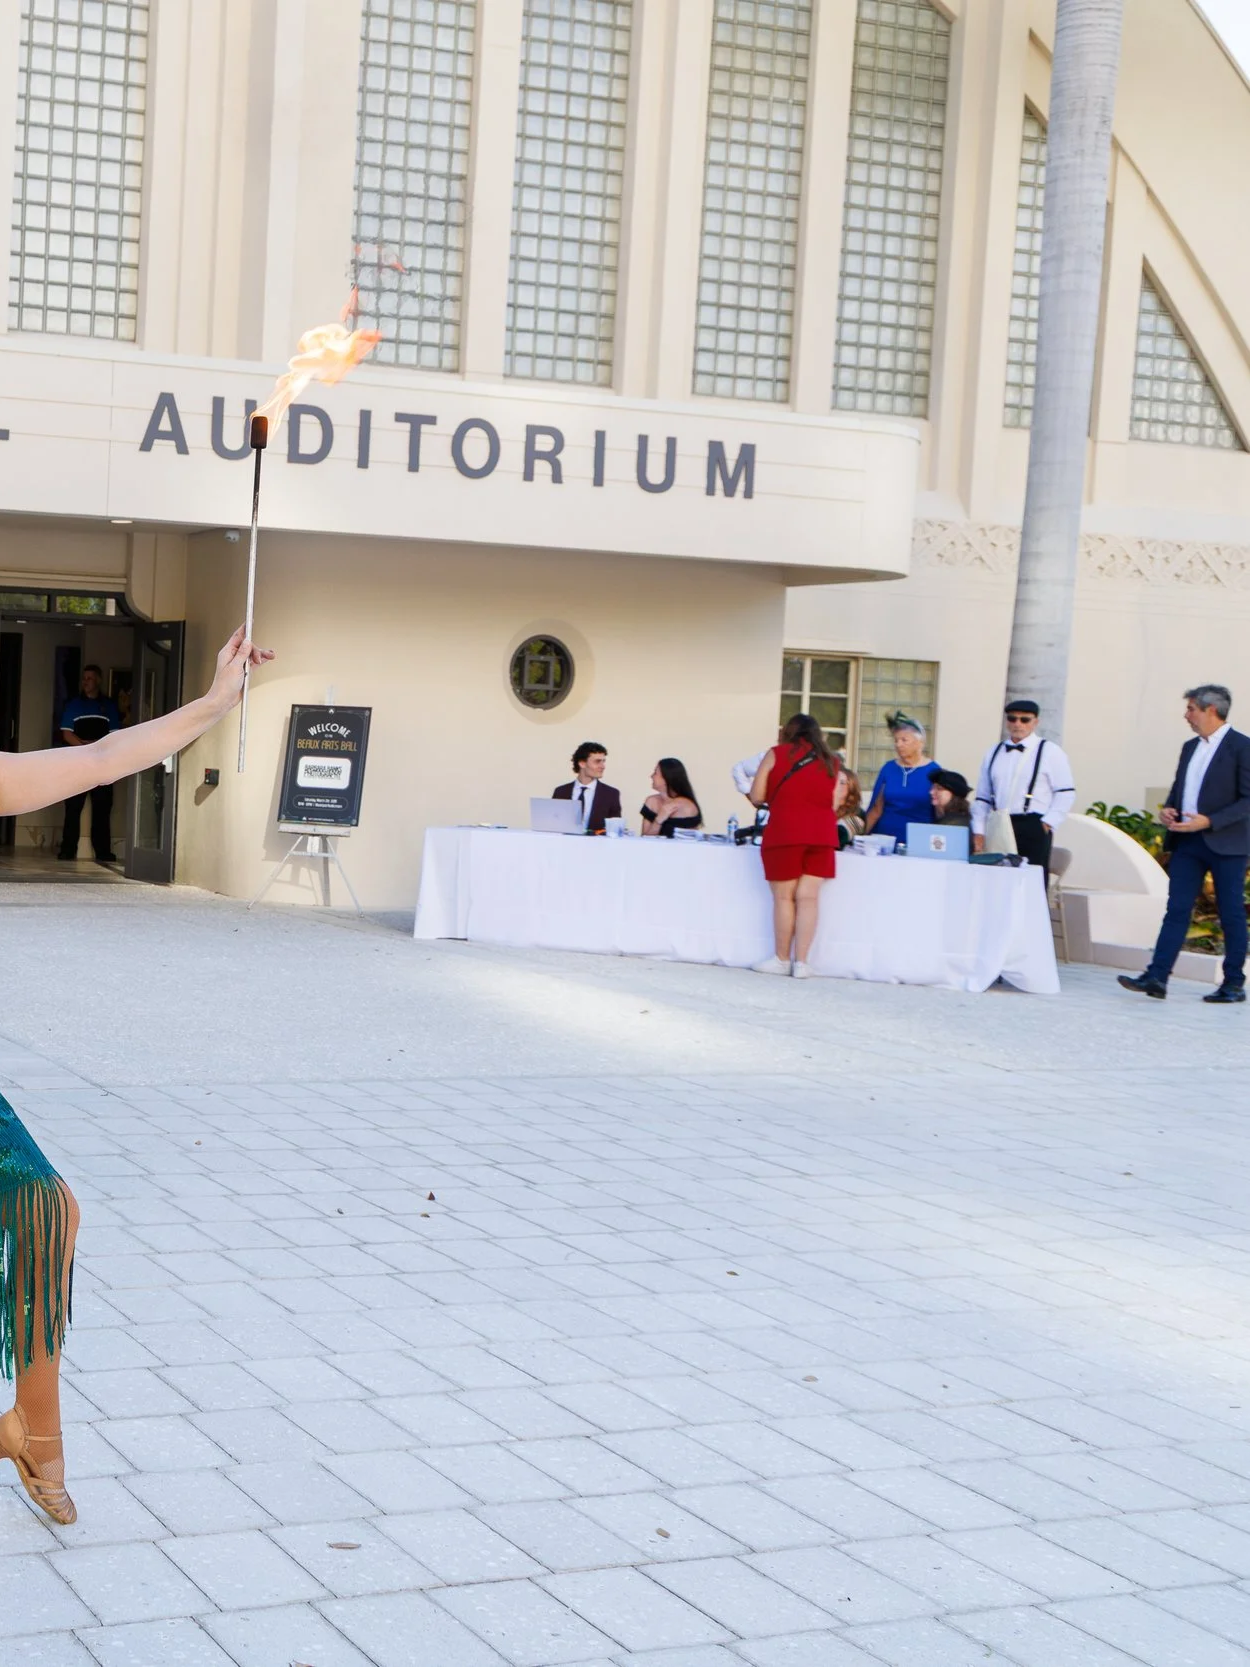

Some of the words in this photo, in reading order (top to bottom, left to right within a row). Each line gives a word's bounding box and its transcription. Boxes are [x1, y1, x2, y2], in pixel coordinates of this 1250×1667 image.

[139, 391, 756, 500] AUDITORIUM
[308, 723, 351, 738] WELCOME
[297, 739, 320, 749] BEAUX
[321, 740, 339, 750] ARTS
[340, 741, 357, 752] BALL
